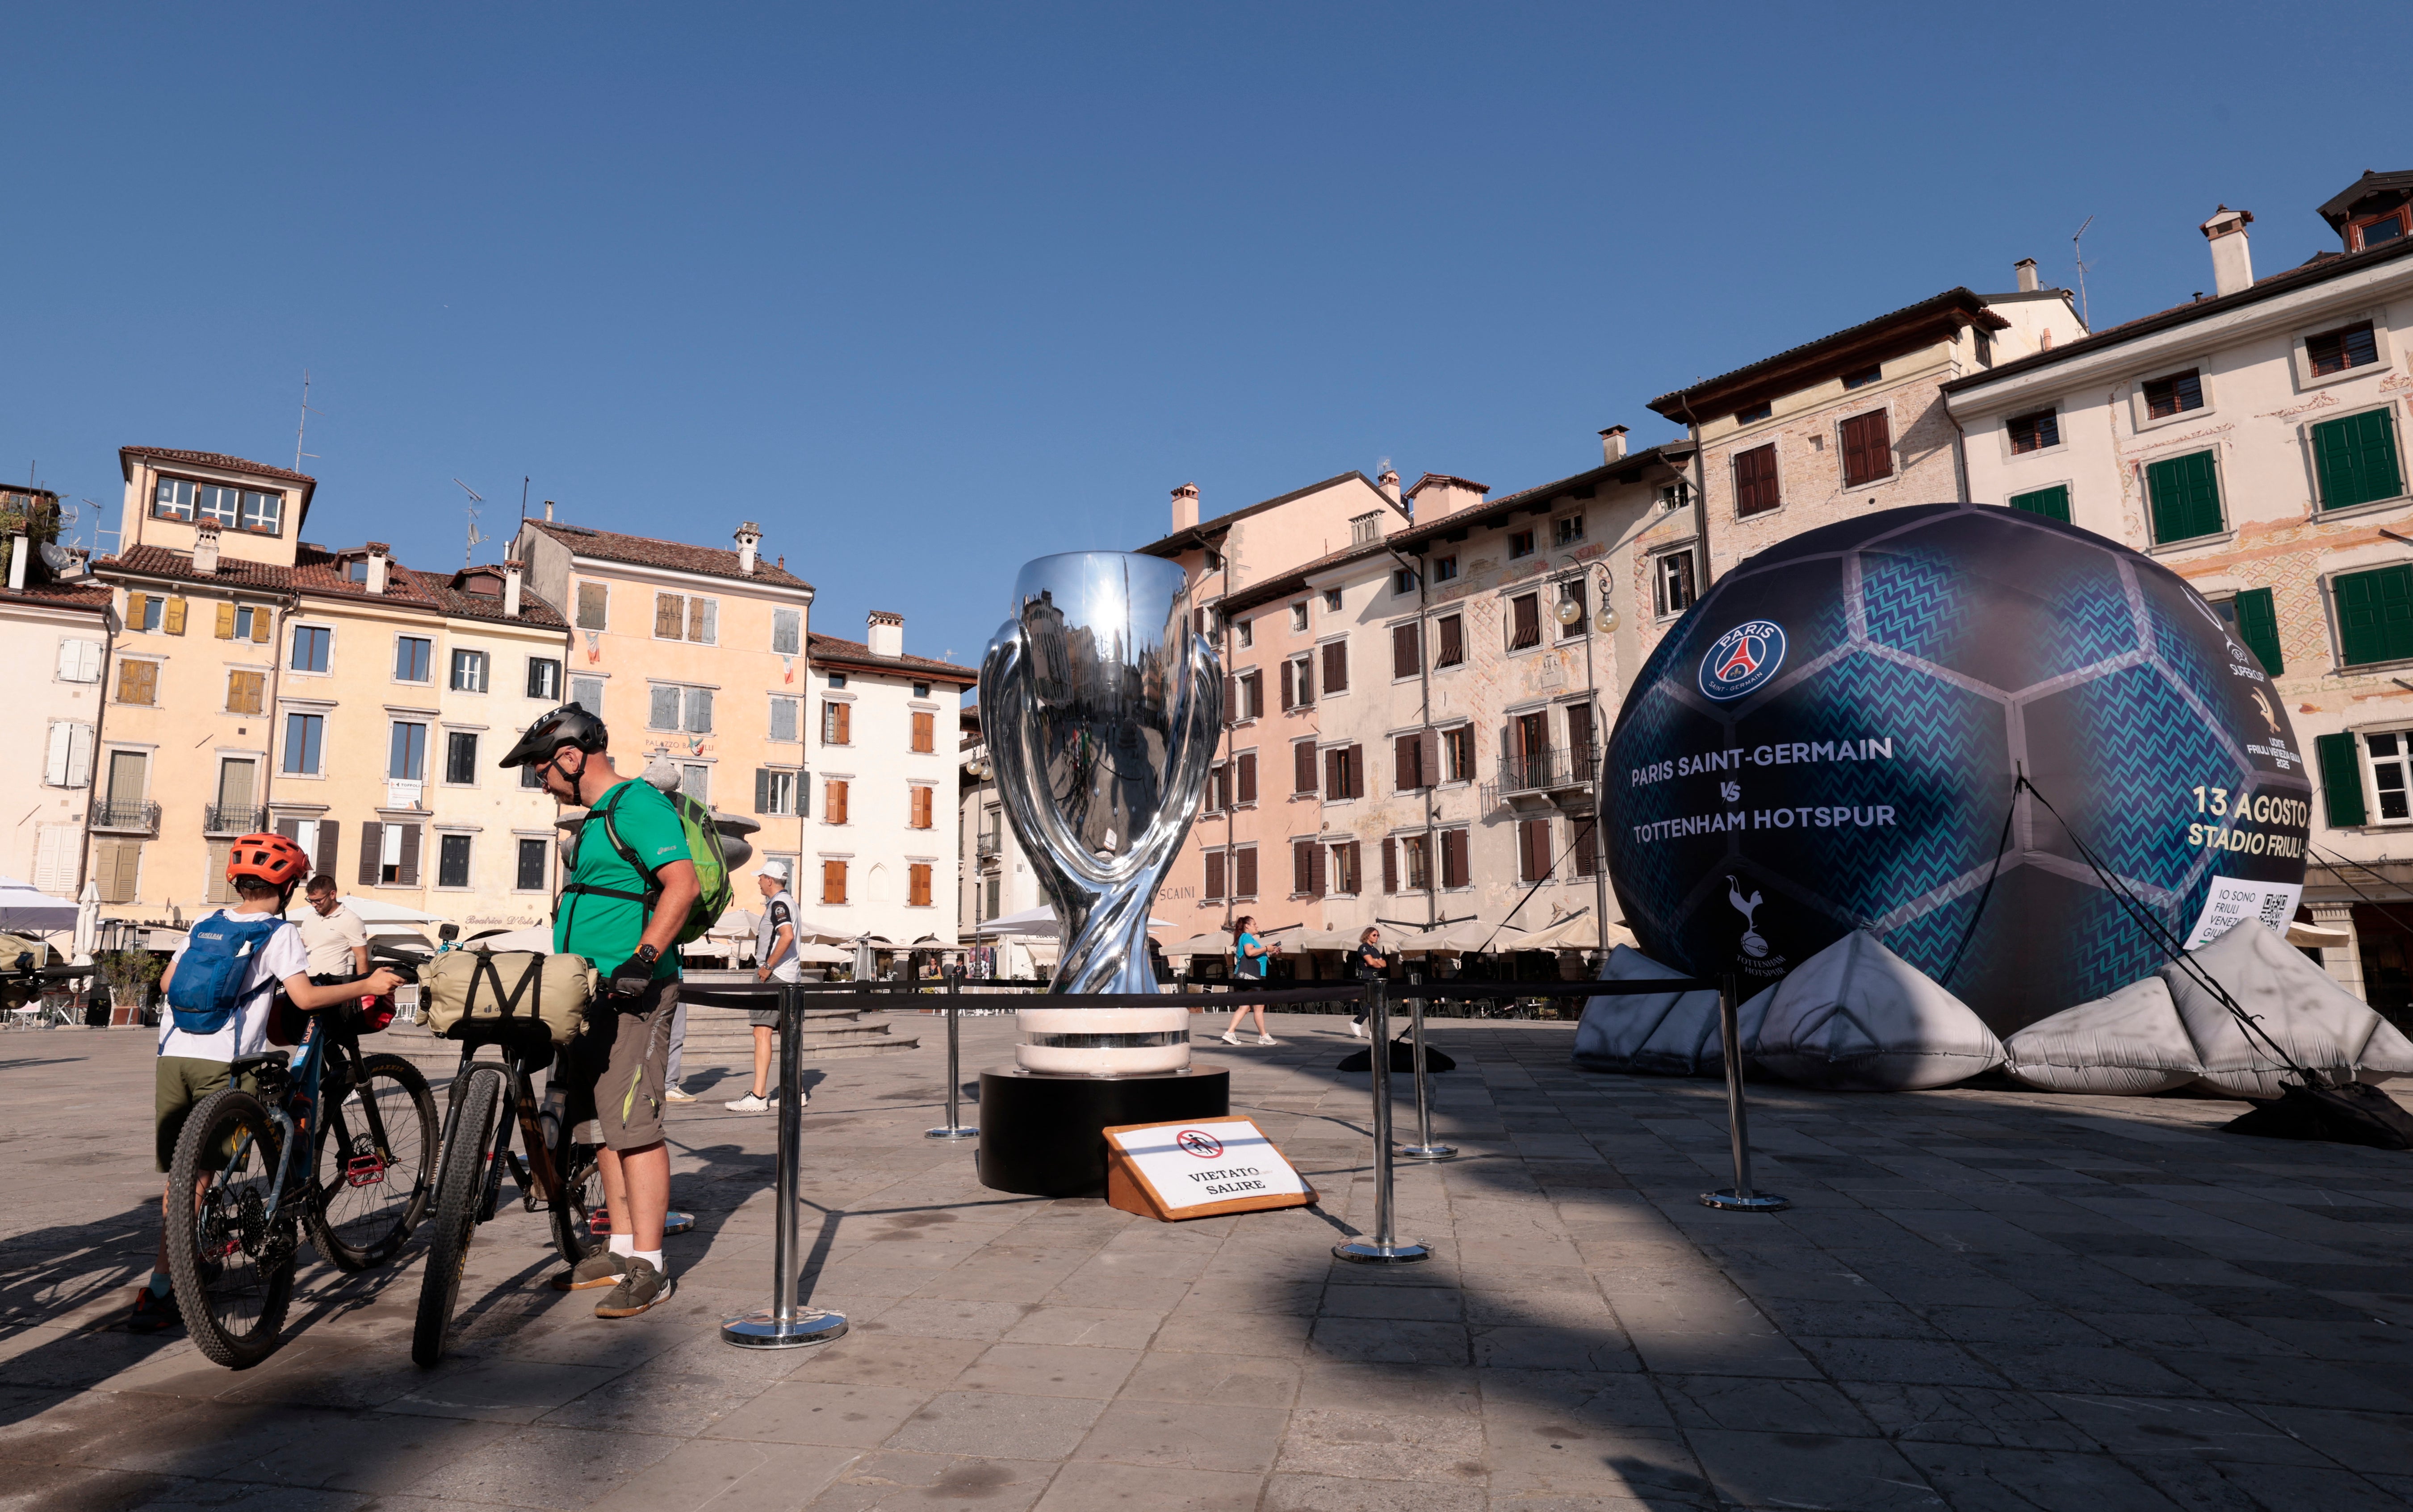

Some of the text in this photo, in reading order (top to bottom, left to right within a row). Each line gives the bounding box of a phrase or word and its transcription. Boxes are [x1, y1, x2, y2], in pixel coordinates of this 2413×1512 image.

[1719, 624, 1774, 647] PARIS
[534, 709, 559, 730] FOX
[2269, 737, 2286, 749] UDINE
[2246, 745, 2270, 755] FRIULI
[2269, 747, 2291, 760] VENEZIA
[1632, 737, 1893, 787] PARIS SAINT-GERMAIN
[2275, 758, 2290, 770] 2025
[2193, 785, 2227, 816] 13
[2234, 793, 2307, 828] AGOSTO
[1634, 805, 1897, 843] TOTTENHAM HOTSPUR
[2188, 823, 2265, 855] STADIO
[2266, 835, 2301, 858] FRIULI
[1160, 886, 1194, 900] SCAINI
[2219, 889, 2256, 902] IO SONO
[2214, 902, 2239, 914] FRIULI
[465, 916, 534, 925] Beatrice D'Este
[197, 932, 223, 941] CAMELBAK
[1737, 954, 1786, 968] TOTTENHAM
[1745, 966, 1786, 977] HOTSPUR
[1188, 1167, 1259, 1182] VIETATO
[1206, 1180, 1266, 1194] SALIRE
